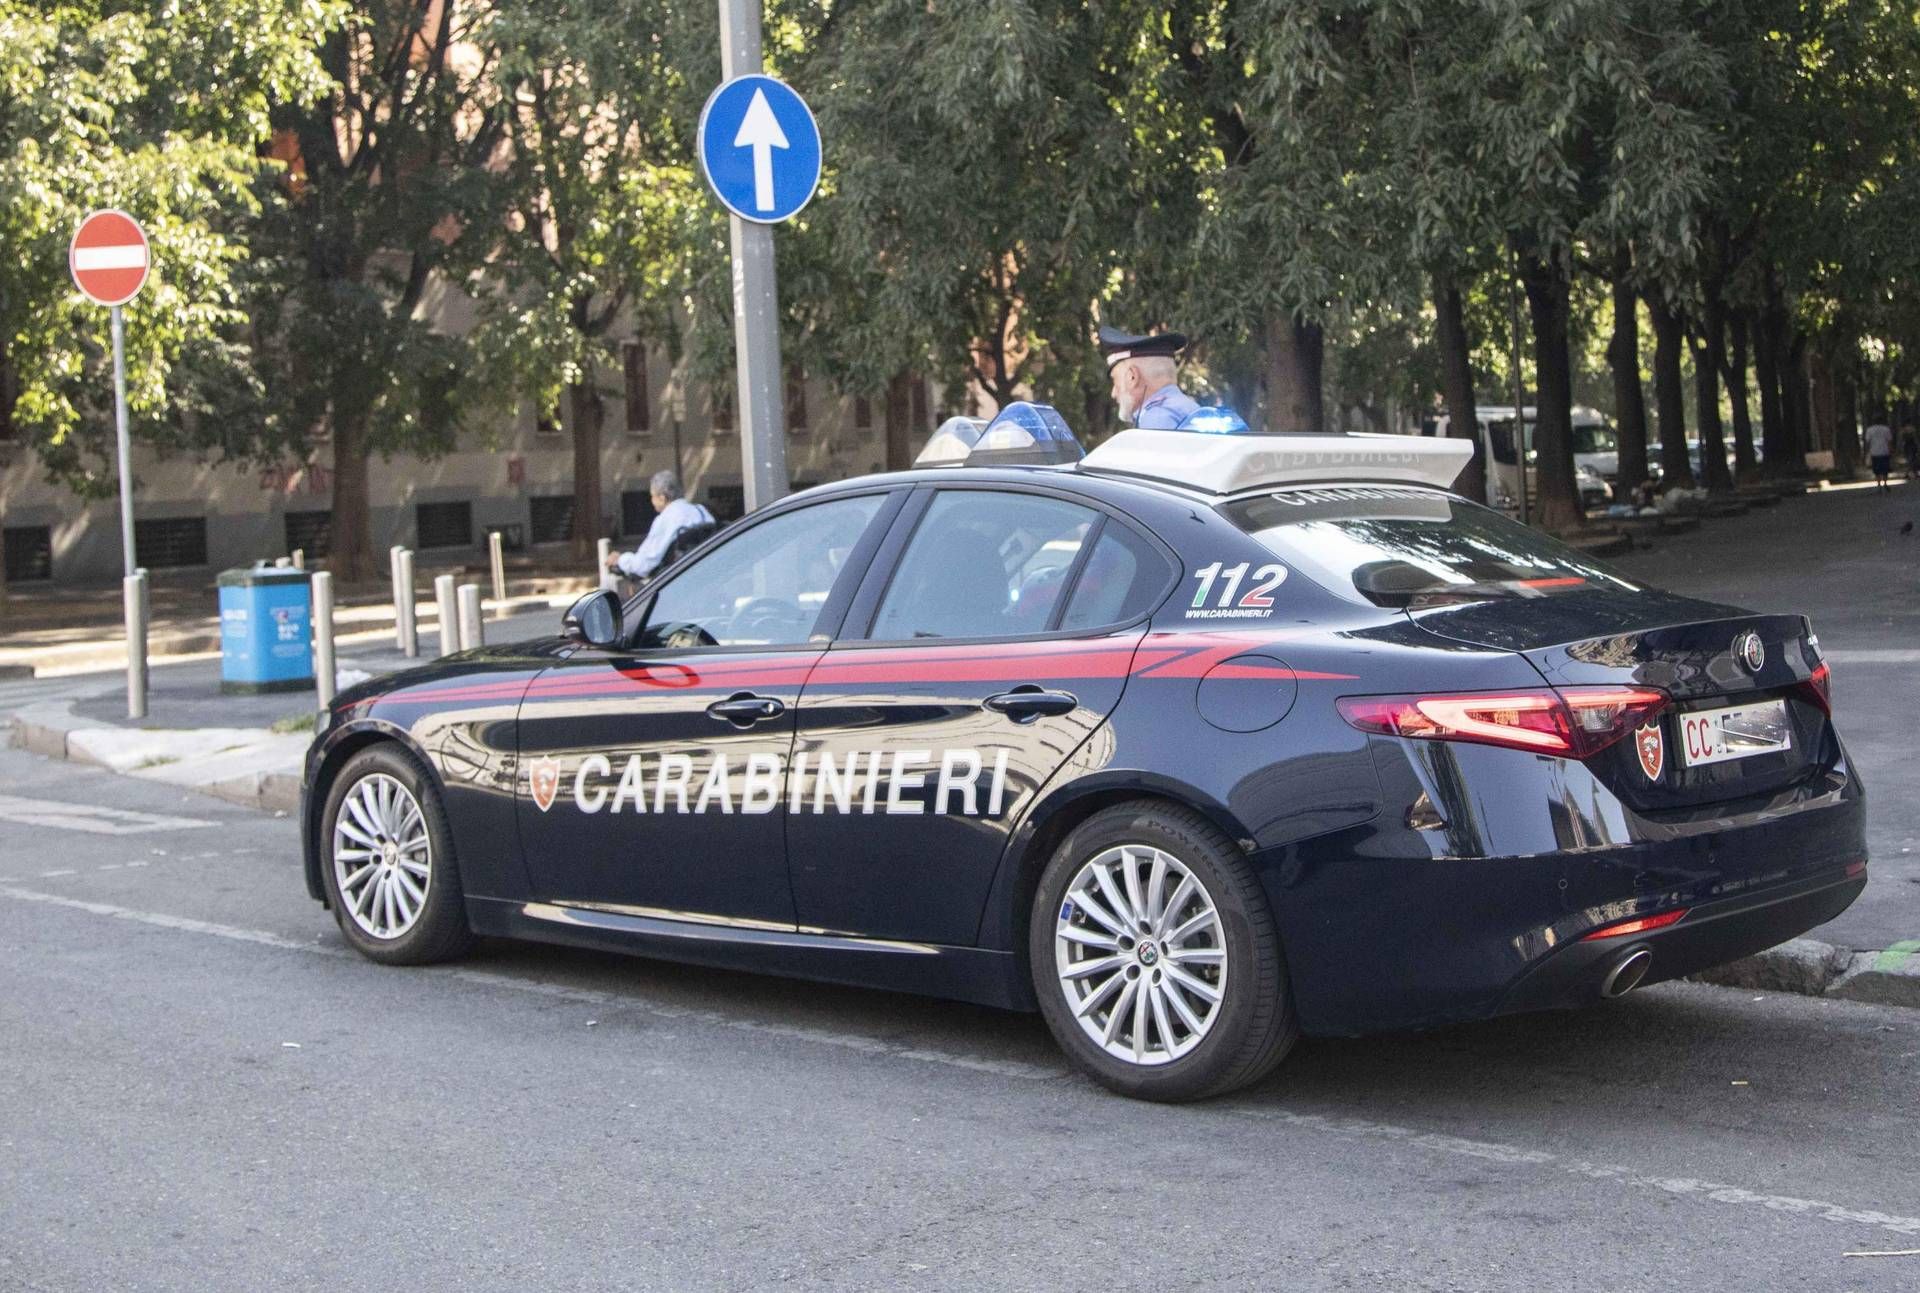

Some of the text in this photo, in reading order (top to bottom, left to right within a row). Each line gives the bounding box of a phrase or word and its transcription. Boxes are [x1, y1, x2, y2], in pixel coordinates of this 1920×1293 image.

[1191, 562, 1289, 608] 112
[1185, 609, 1273, 619] WWW.CARABINIERI.IT
[1686, 718, 1713, 759] CC
[573, 748, 1011, 815] CARABINIERI
